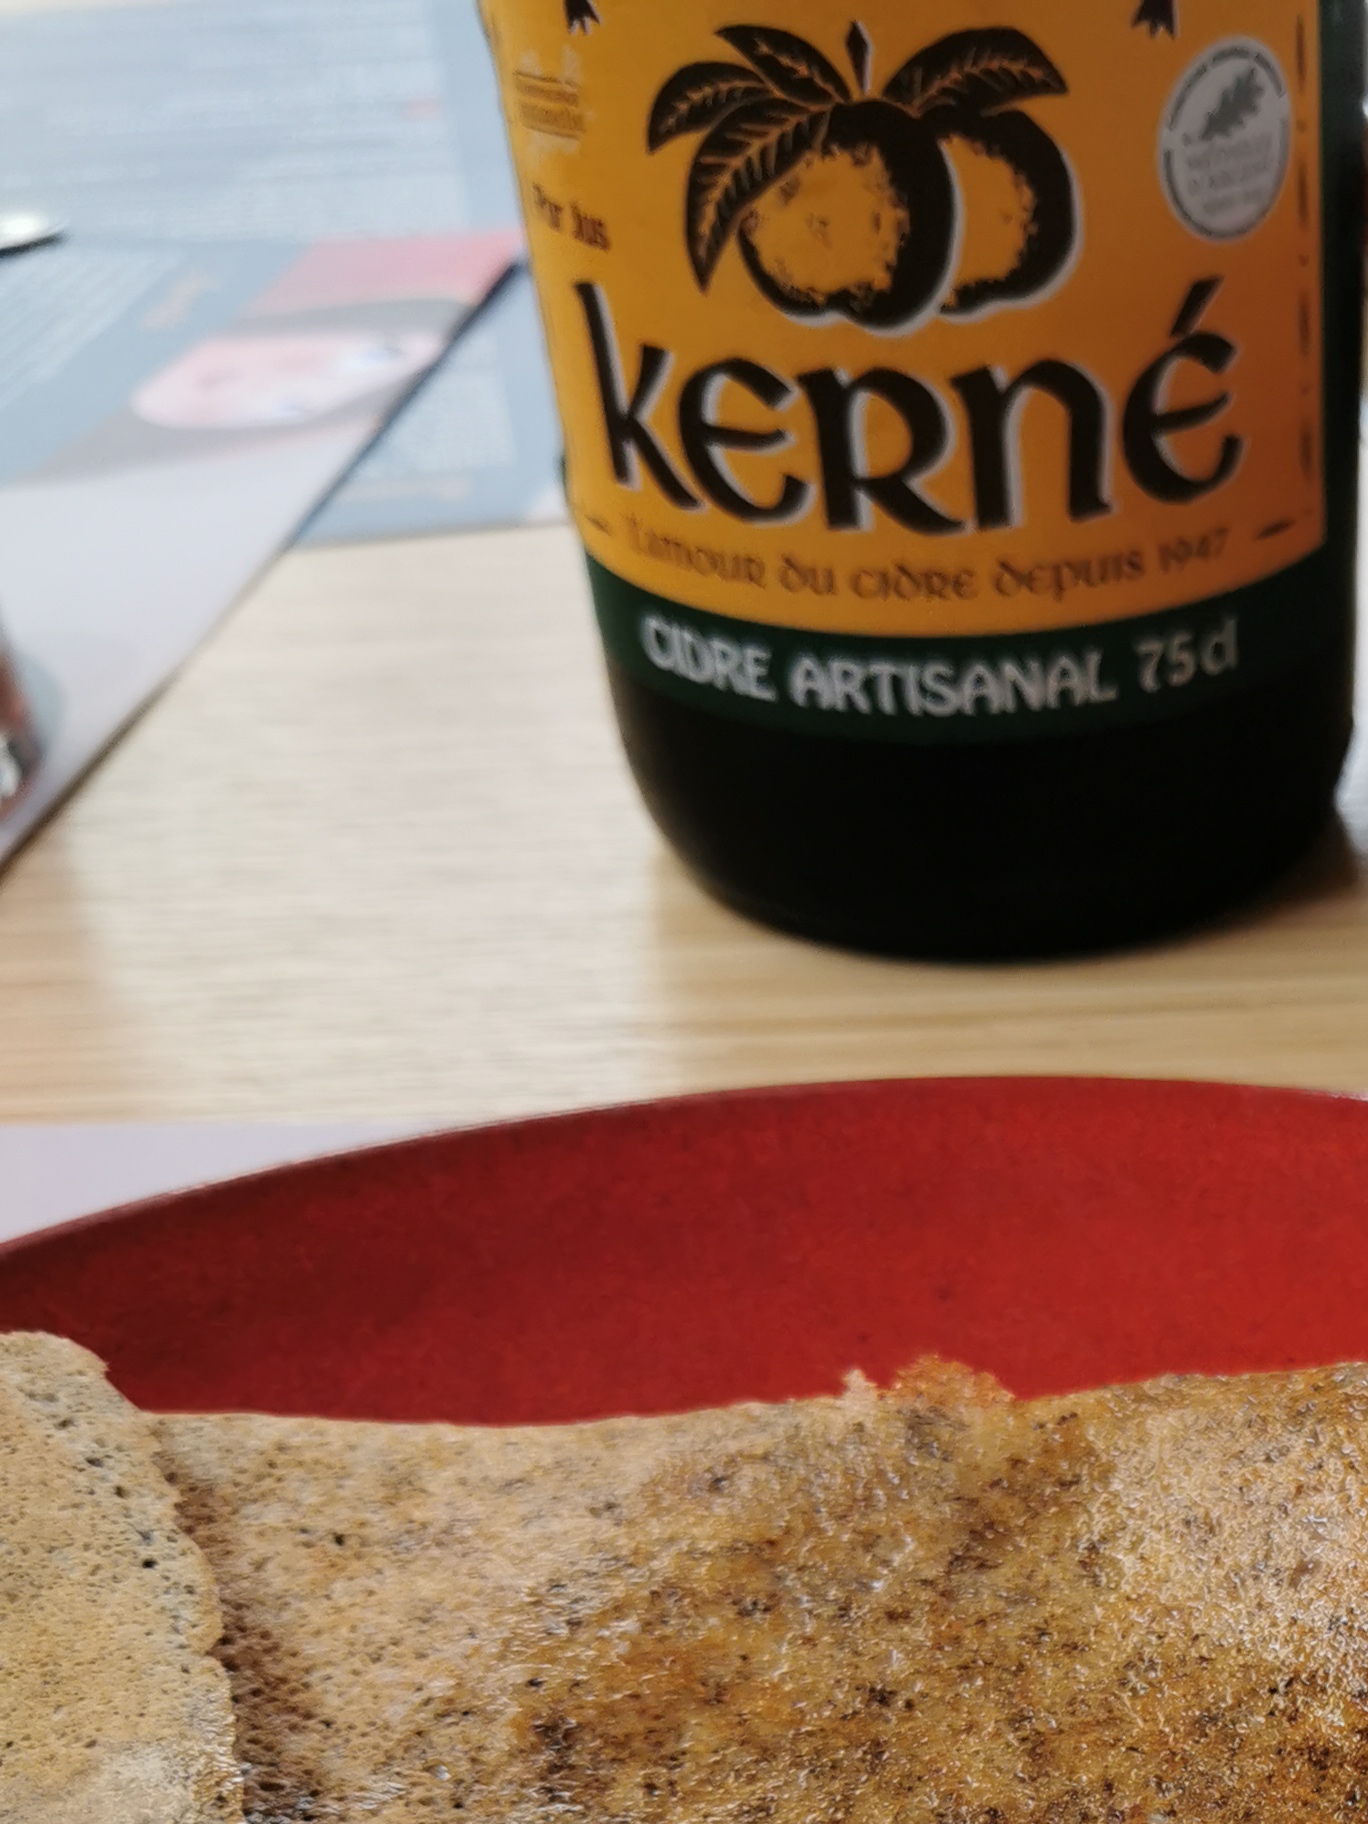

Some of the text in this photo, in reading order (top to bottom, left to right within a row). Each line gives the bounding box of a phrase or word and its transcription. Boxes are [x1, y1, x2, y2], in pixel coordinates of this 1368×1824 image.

[778, 553, 838, 597] du
[641, 613, 776, 701] CIDRE
[790, 648, 1118, 717] ARTISANAL
